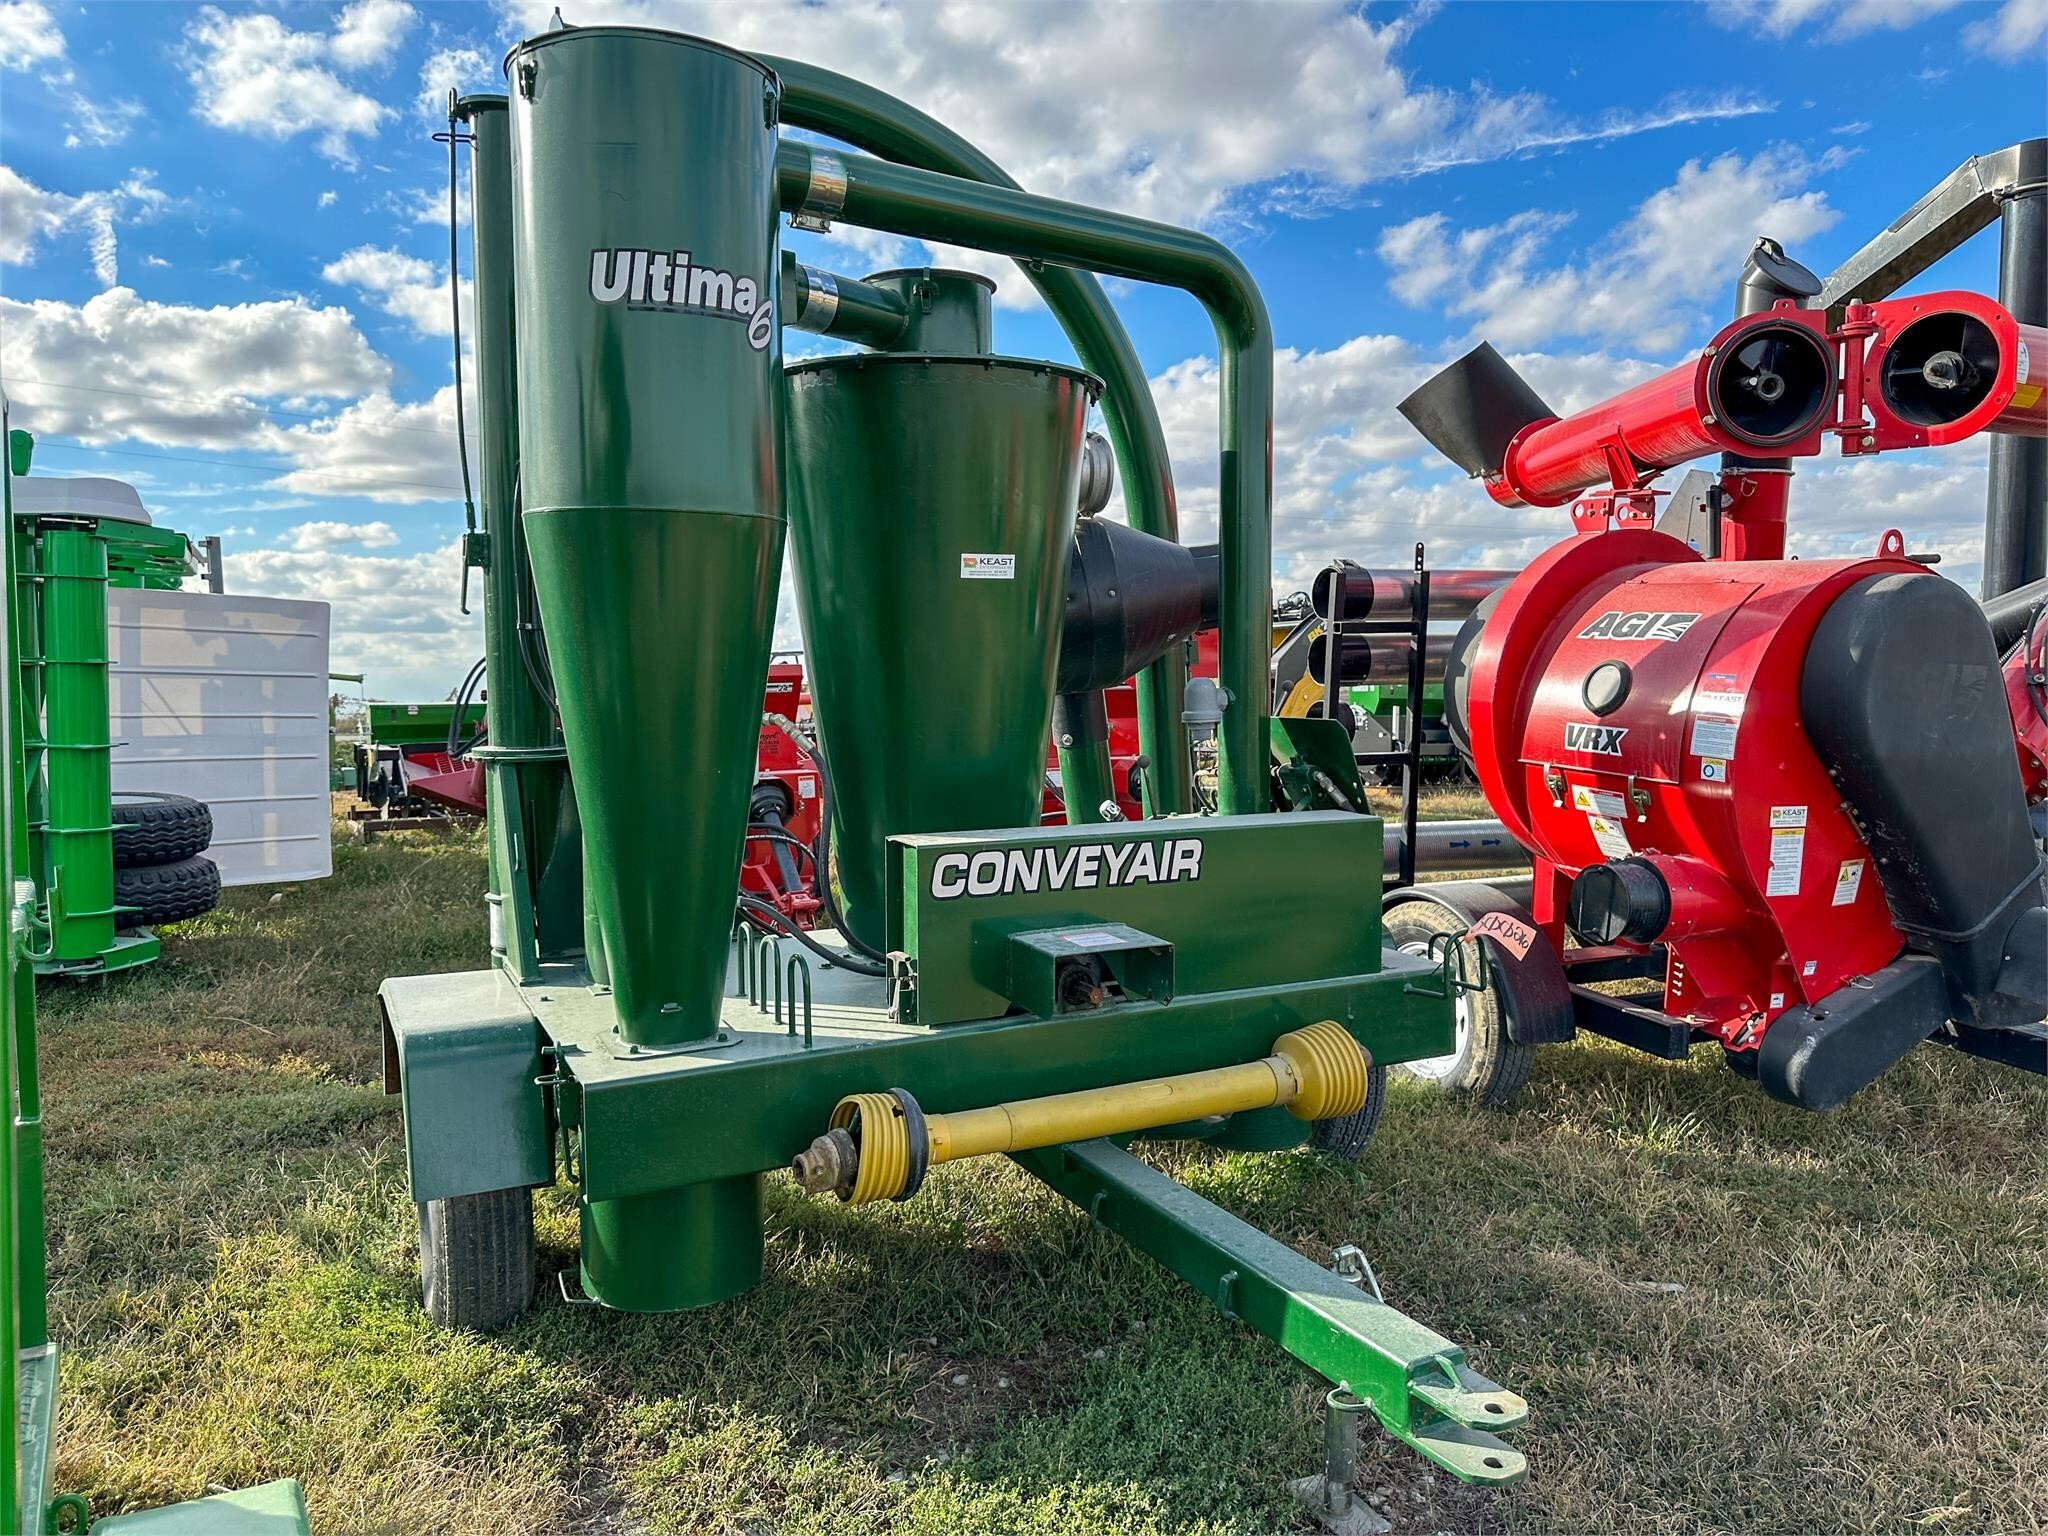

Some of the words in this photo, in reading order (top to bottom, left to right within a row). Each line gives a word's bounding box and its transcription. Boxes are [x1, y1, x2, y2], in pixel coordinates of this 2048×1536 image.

[589, 249, 758, 318] Ultima
[747, 298, 774, 351] 6
[980, 557, 1013, 566] KEAST
[1579, 612, 1665, 639] AGI
[1567, 725, 1626, 754] VRX
[1782, 808, 1806, 816] KEAST
[931, 839, 1203, 899] CONVEYAIR
